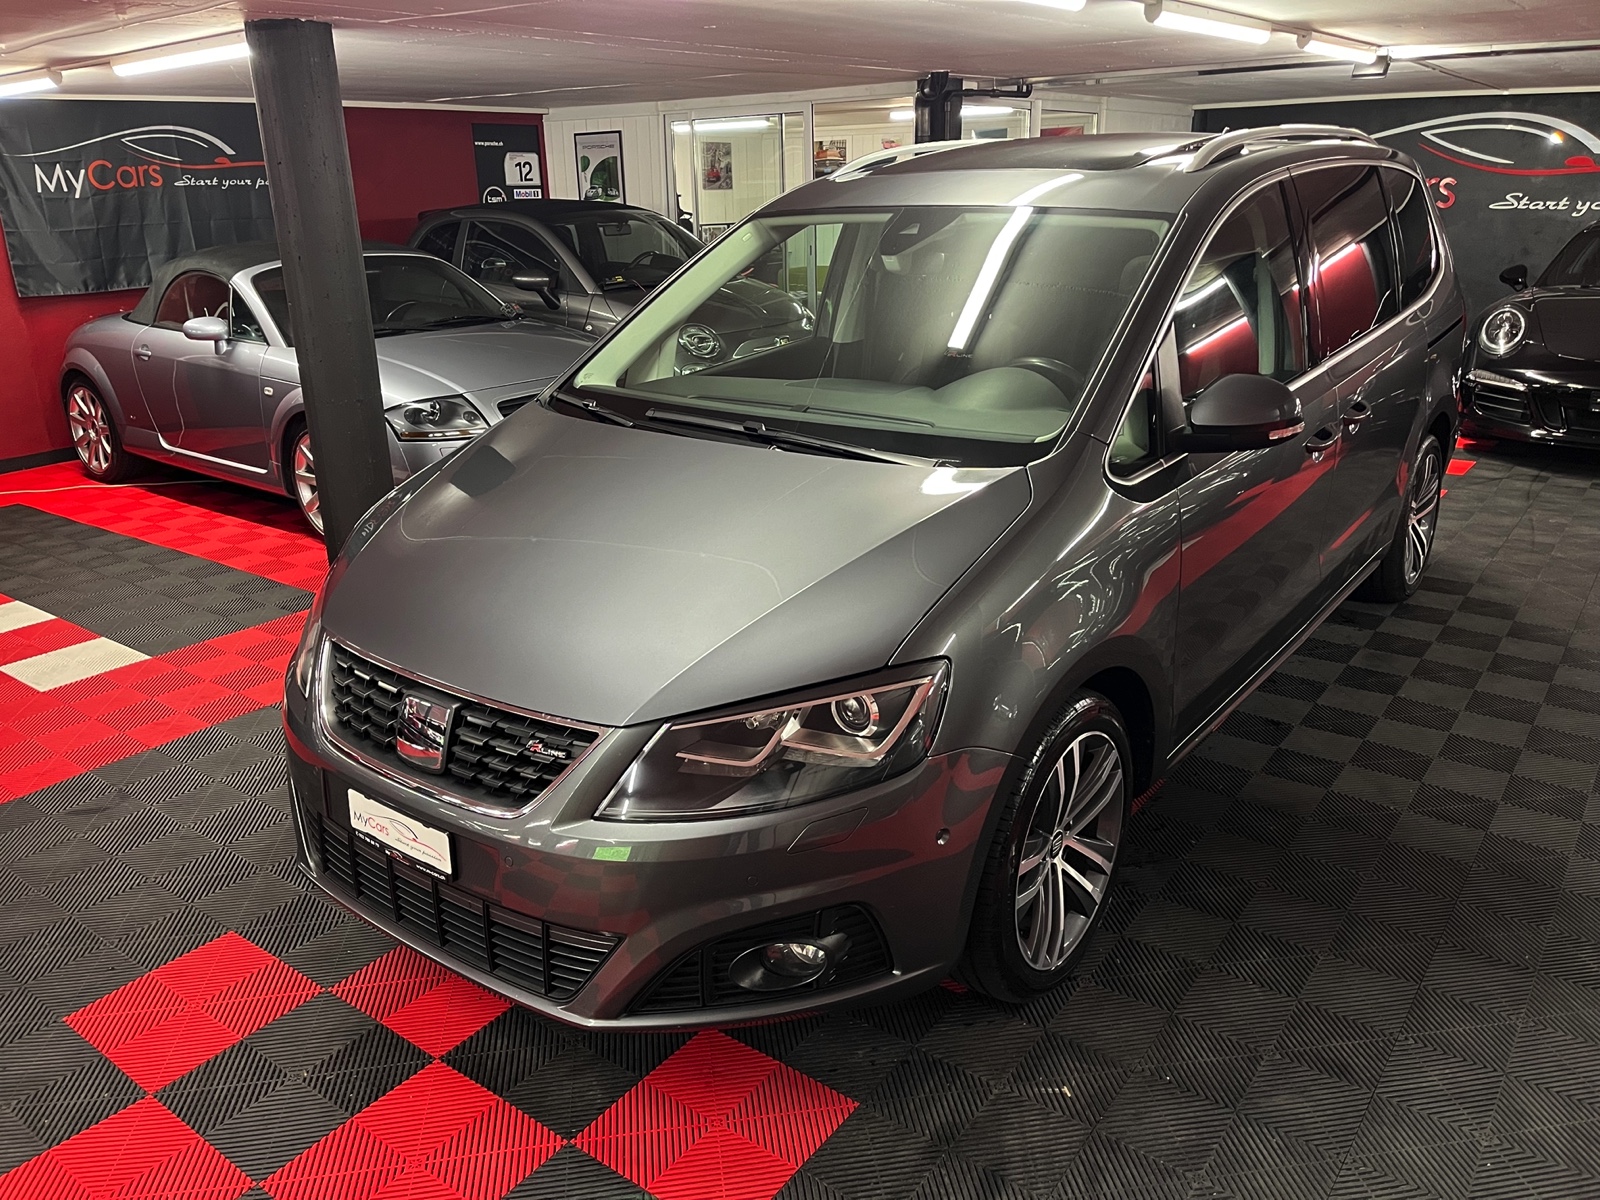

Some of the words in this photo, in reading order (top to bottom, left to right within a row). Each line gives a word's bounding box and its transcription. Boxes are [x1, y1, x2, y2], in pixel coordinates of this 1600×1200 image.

[34, 159, 163, 198] MyCars
[174, 174, 218, 186] Start
[221, 178, 252, 190] your
[514, 161, 534, 182] 12
[515, 190, 532, 198] Mobil
[1489, 192, 1570, 210] Start
[1571, 199, 1600, 217] yo
[353, 810, 390, 836] MyCars
